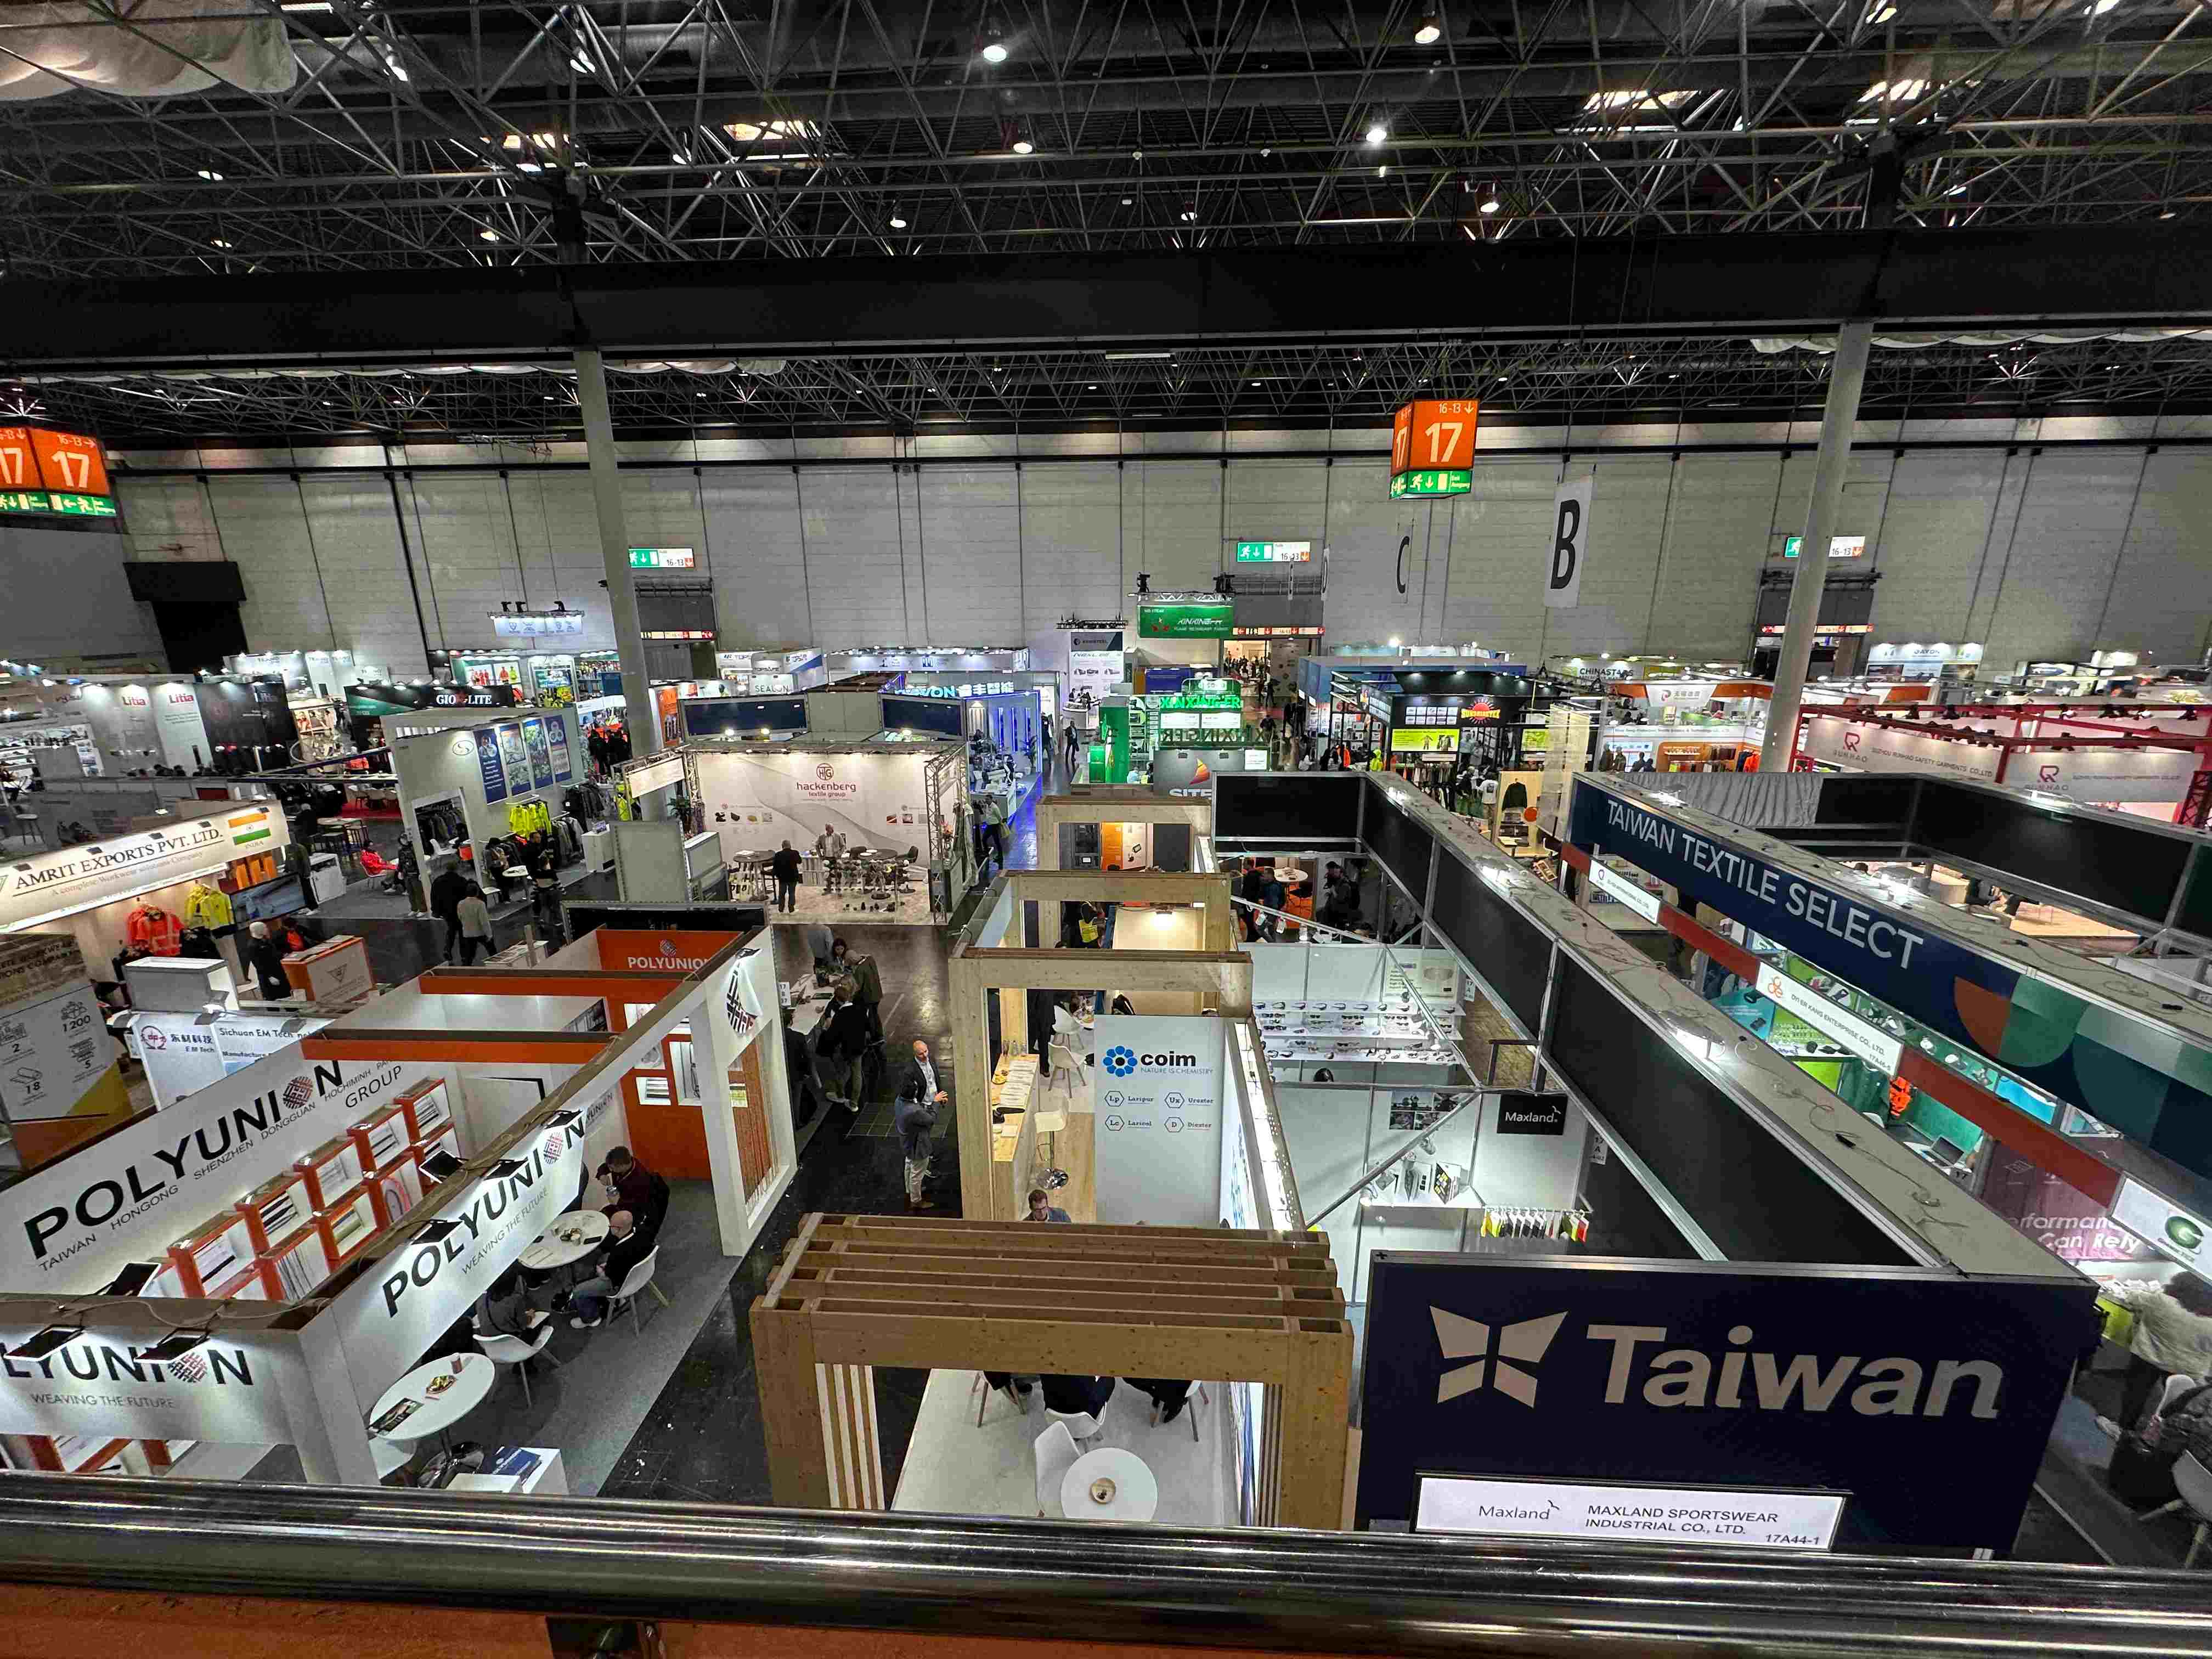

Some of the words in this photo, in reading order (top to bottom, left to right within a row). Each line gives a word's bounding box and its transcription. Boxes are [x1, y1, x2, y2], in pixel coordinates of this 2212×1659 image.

[1425, 422, 1463, 462] 17
[51, 450, 89, 488] 17
[1550, 499, 1580, 589] B
[1397, 536, 1409, 594] C
[123, 696, 146, 706] Litia
[168, 693, 194, 703] Litia
[797, 782, 856, 792] hackenberg
[16, 862, 76, 889] AMRIT
[80, 844, 155, 877] EXPORTS
[157, 834, 190, 861] PVT.
[193, 829, 223, 855] LTD.
[1608, 799, 1676, 854] TAIWAN
[1682, 833, 1780, 905] TEXTILE
[1785, 883, 1923, 970] SELECT
[63, 1015, 91, 1032] 1200
[219, 1027, 255, 1037] Sichuan
[256, 1029, 270, 1037] EM
[1824, 1014, 1858, 1040] ENTERPRISE
[12, 1043, 20, 1053] 2
[85, 1060, 91, 1069] 5
[1141, 1051, 1196, 1066] coim
[27, 1081, 40, 1094] 18
[345, 1065, 402, 1108] GROUP
[40, 1233, 96, 1271] TAIWAN
[111, 1184, 179, 1230] HONGONG
[194, 1139, 253, 1181] SHENZHEN
[261, 1101, 315, 1140] DONGGUAN
[324, 1070, 371, 1102] HOCHIMINH
[462, 1228, 505, 1275] WEAVING
[506, 1214, 522, 1233] THE
[522, 1187, 549, 1217] FUTURE
[2038, 1232, 2082, 1249] Can
[2092, 1232, 2140, 1252] Rely
[1586, 1324, 2005, 1420] Taiwan
[31, 1393, 98, 1406] WEAVING
[99, 1395, 124, 1407] THE
[125, 1396, 176, 1409] FUTURE
[1479, 1504, 1550, 1520] Maxland
[1588, 1505, 1664, 1519] MAXLAND
[1668, 1508, 1778, 1522] SPORTSWEAR
[1585, 1518, 1675, 1533] INDUSTRIAL
[1681, 1522, 1712, 1534] CO.,
[1716, 1523, 1747, 1534] LTD.
[1765, 1533, 1820, 1545] 17A44-1
